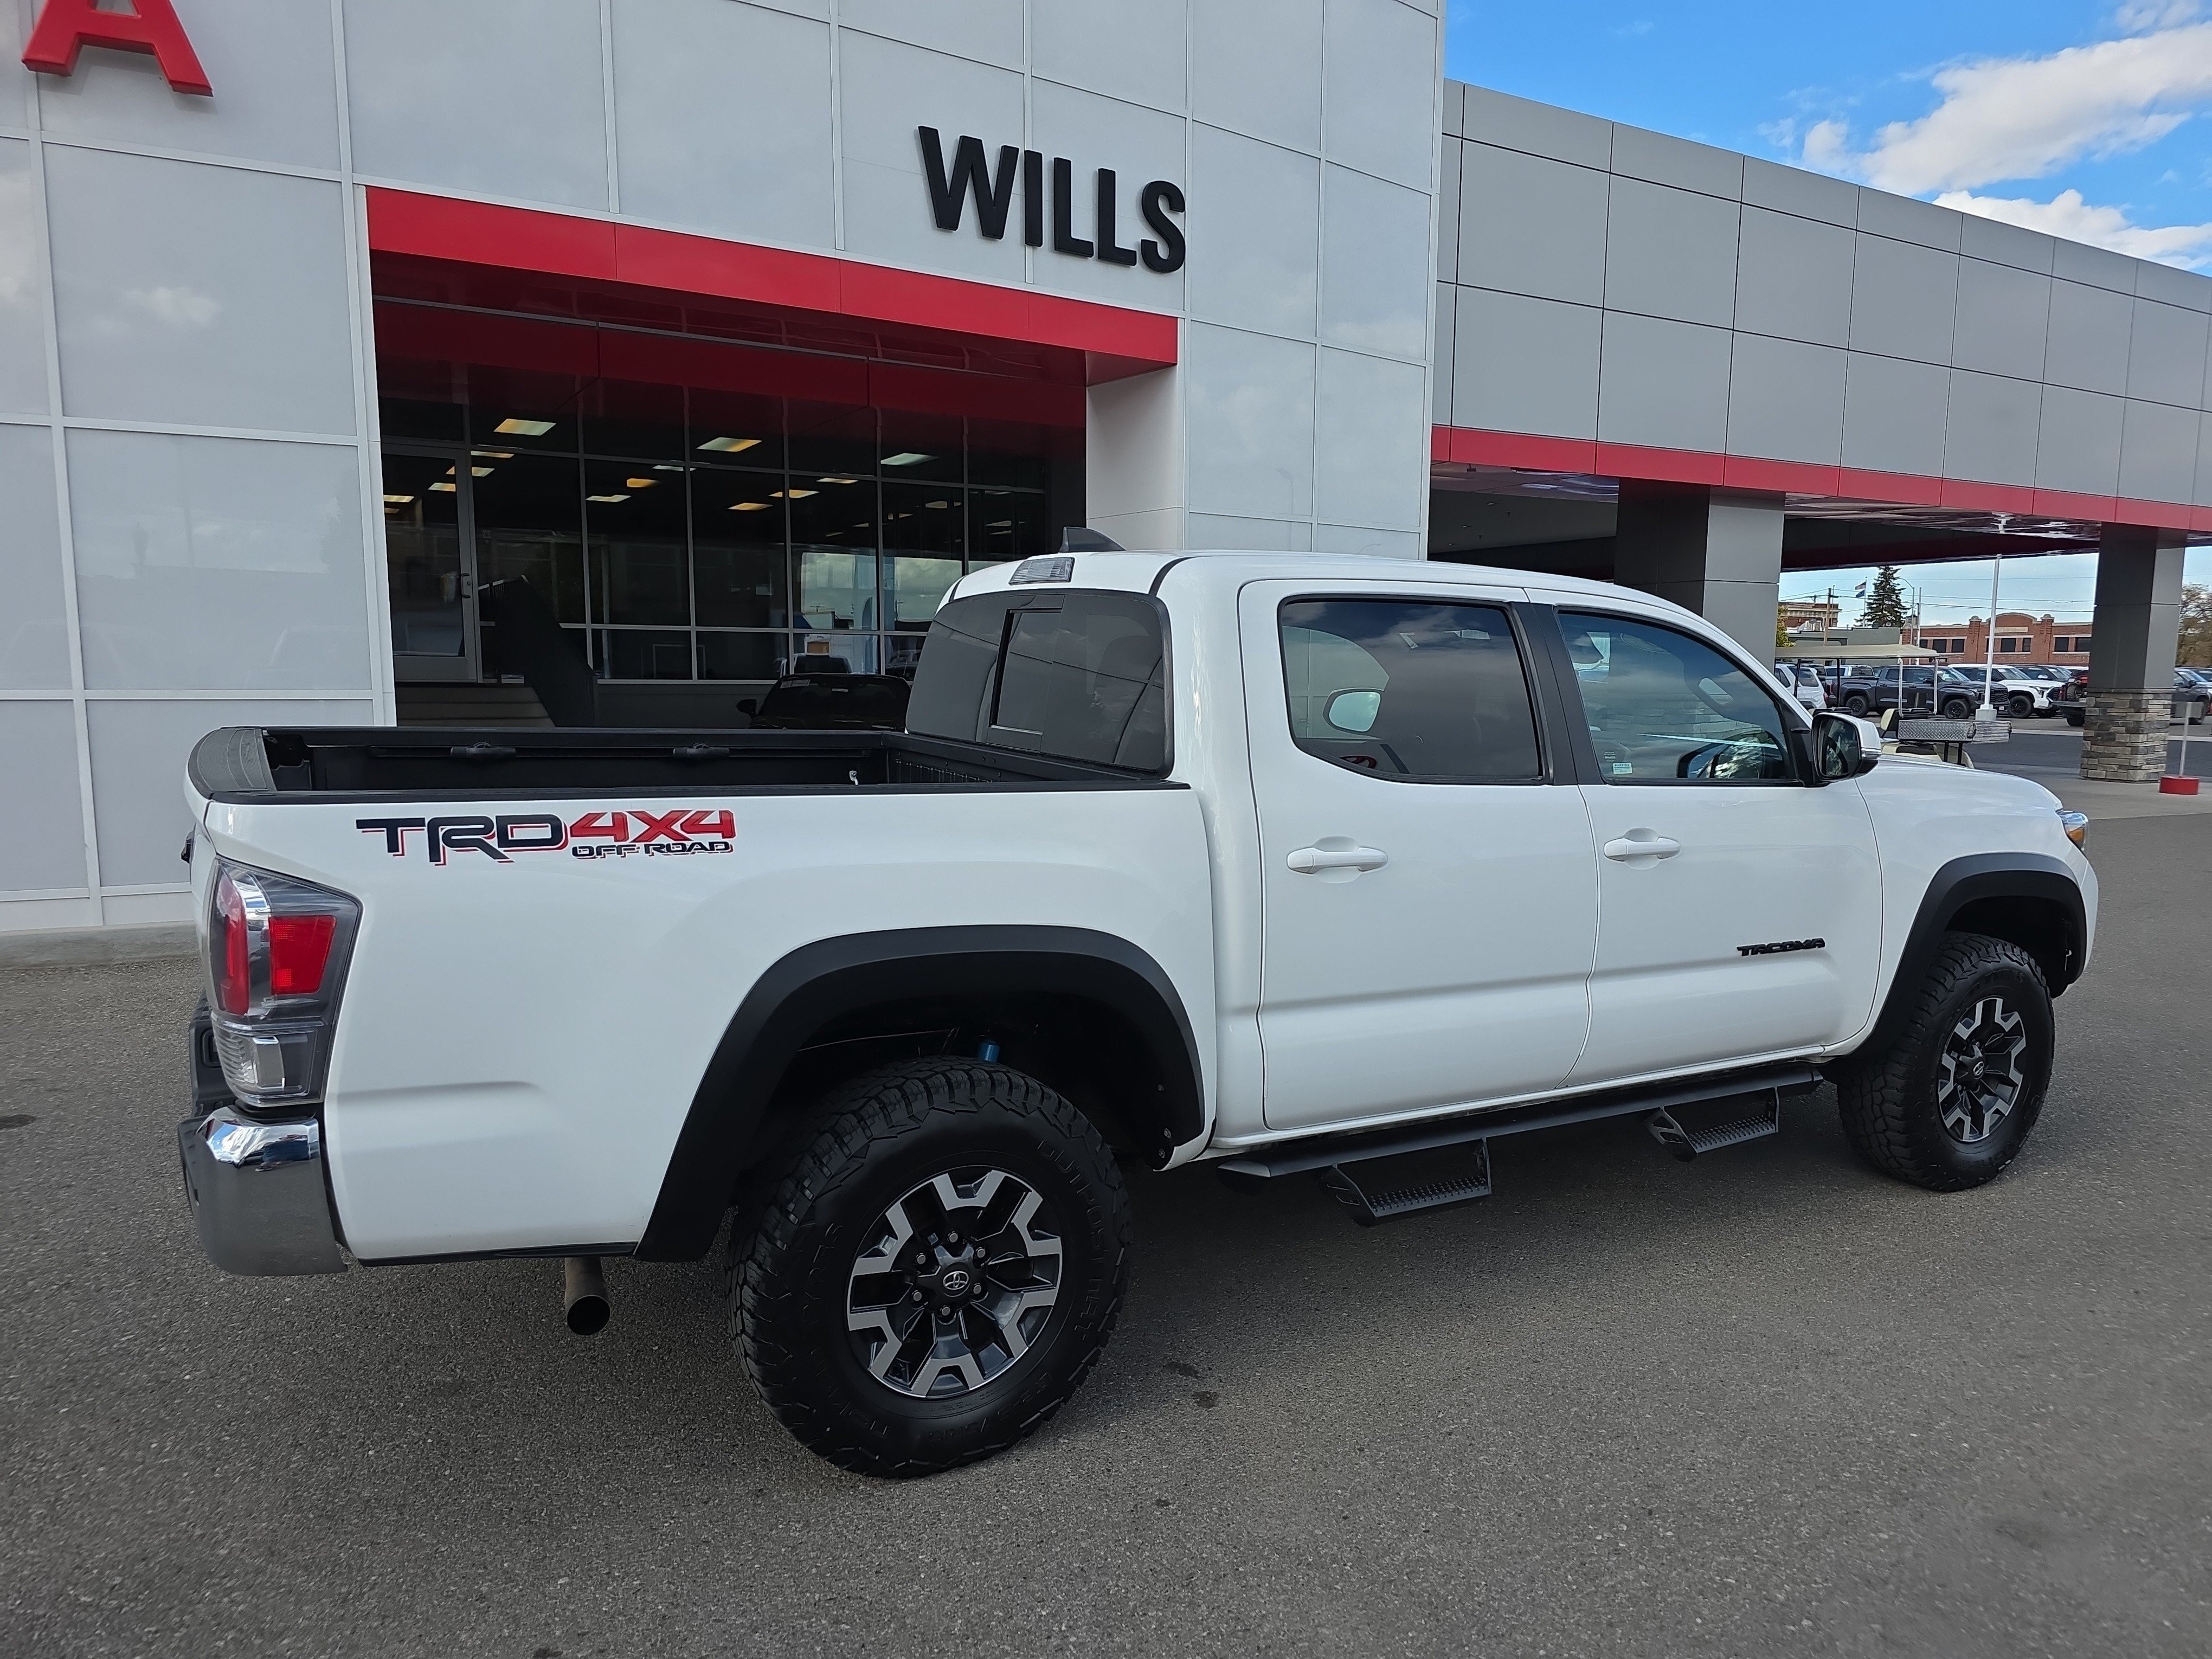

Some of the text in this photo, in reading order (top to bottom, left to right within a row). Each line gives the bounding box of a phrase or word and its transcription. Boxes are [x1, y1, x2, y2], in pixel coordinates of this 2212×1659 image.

[918, 126, 1186, 272] WILLS
[356, 814, 567, 865] TRD
[571, 840, 734, 860] OFF ROAD
[1737, 938, 1825, 956] TACOMA
